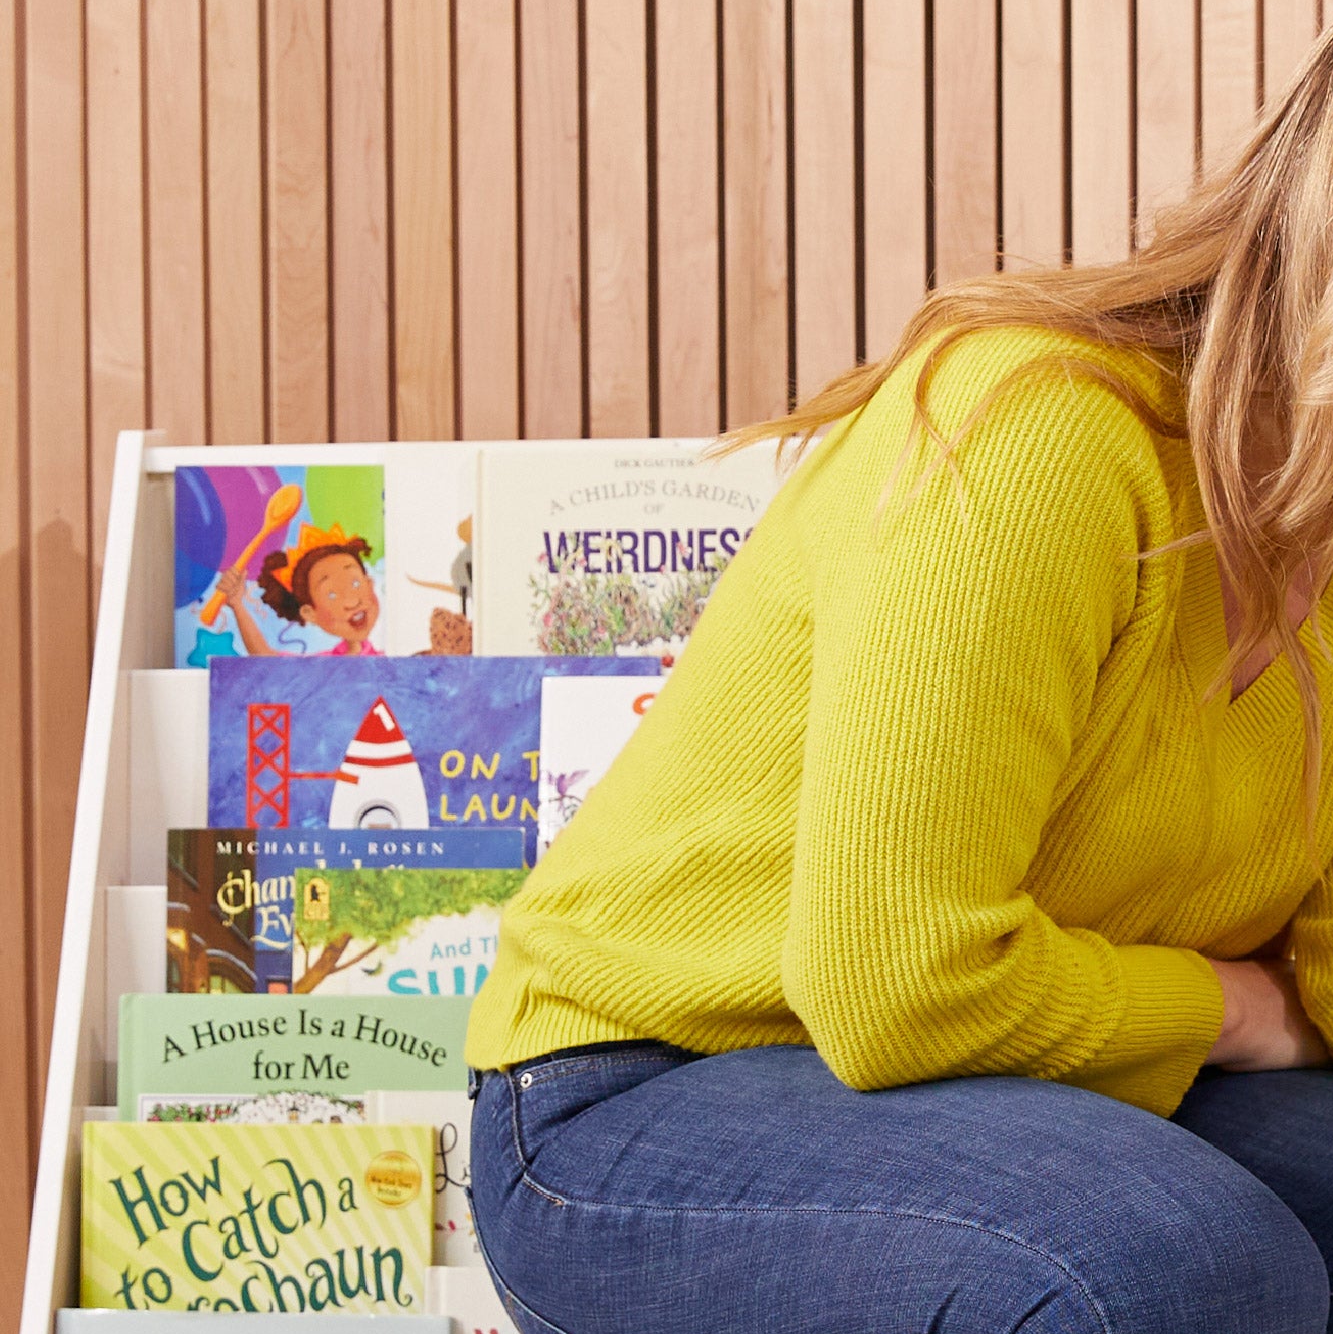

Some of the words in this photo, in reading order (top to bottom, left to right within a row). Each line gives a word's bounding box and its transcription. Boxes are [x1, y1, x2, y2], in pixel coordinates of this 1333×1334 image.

[550, 499, 566, 516] A
[569, 479, 656, 506] CHILD'S
[661, 478, 761, 514] GARDEN
[543, 527, 754, 574] WEIRDNES
[439, 749, 500, 780] ON
[216, 841, 325, 855] MICHAEL
[339, 841, 352, 855] J.
[367, 841, 445, 855] ROSEN
[430, 936, 471, 960] And
[162, 1034, 188, 1065] A
[190, 1015, 288, 1051] House
[298, 1008, 323, 1037] Is
[330, 1018, 347, 1039] a
[354, 1013, 448, 1068] House
[252, 1049, 297, 1081] for
[301, 1053, 351, 1081] Me
[109, 1155, 222, 1249] How
[114, 1261, 172, 1310] to
[181, 1158, 329, 1283] Catch
[338, 1176, 359, 1214] a
